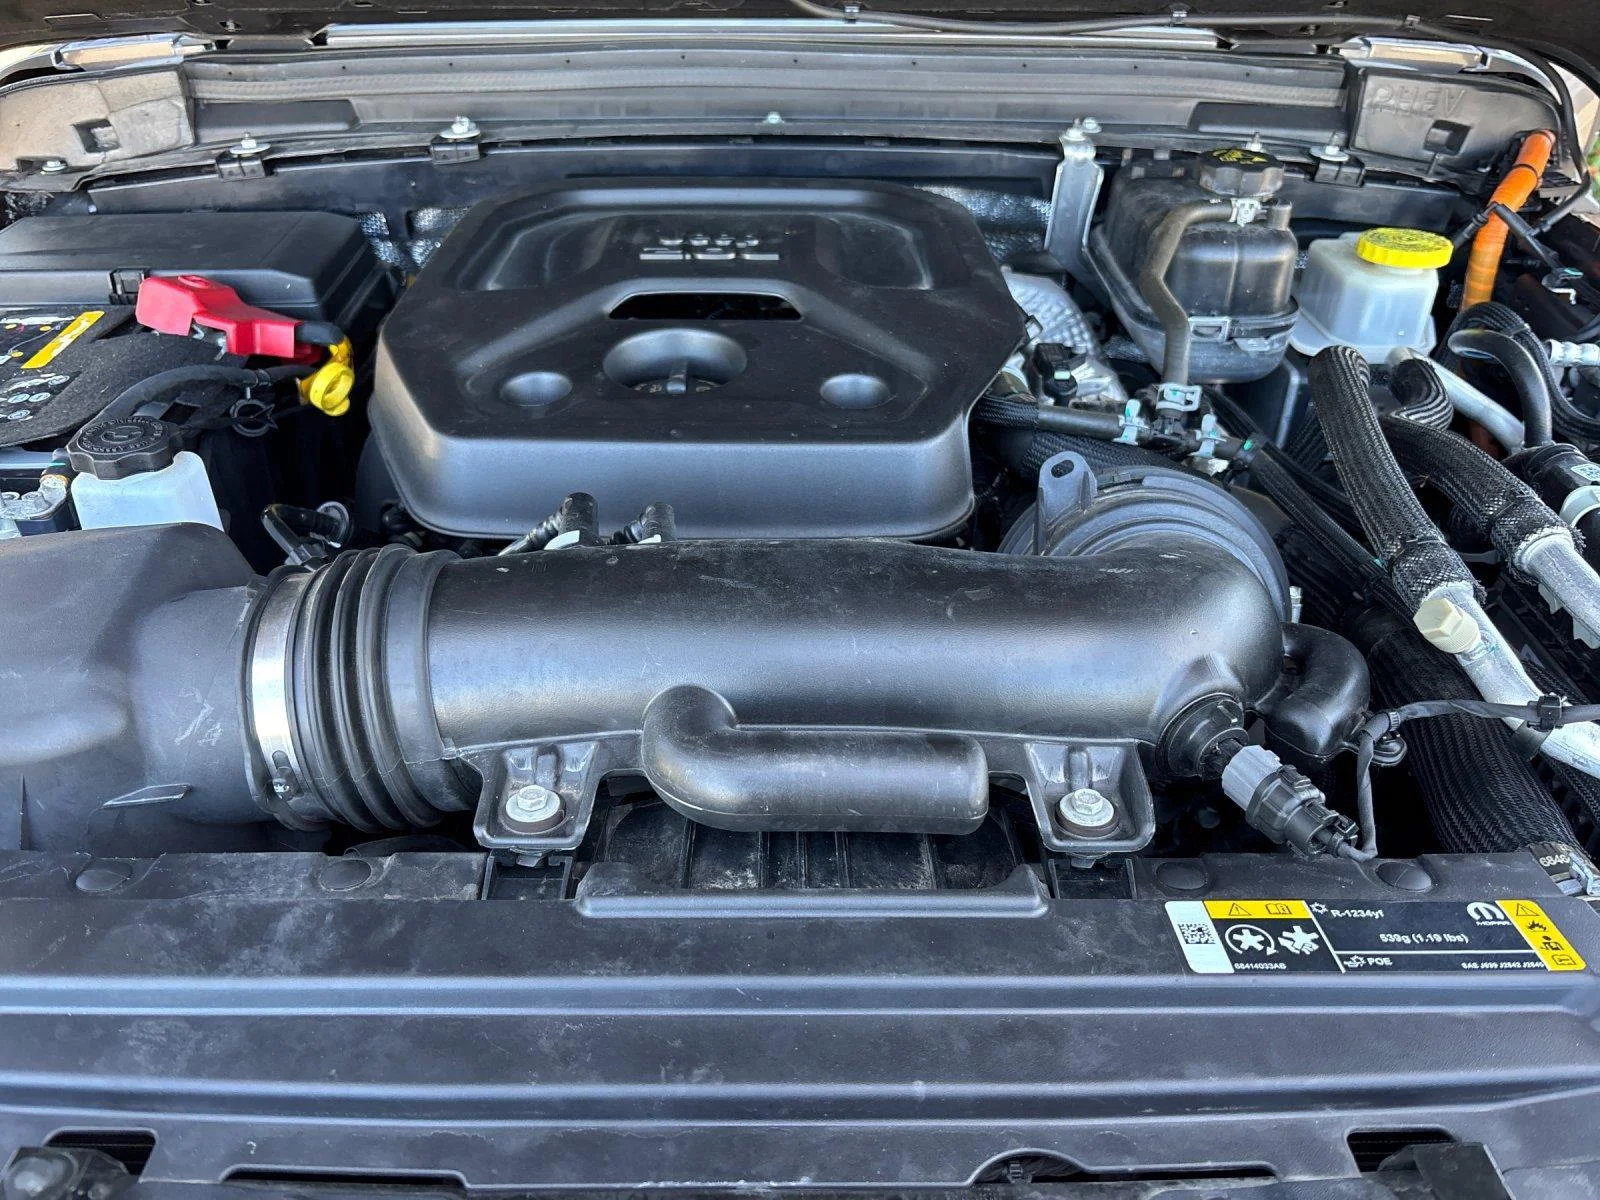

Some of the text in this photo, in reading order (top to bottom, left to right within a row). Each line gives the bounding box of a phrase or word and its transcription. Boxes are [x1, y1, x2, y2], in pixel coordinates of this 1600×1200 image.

[1331, 909, 1384, 919] R-1234yf
[1380, 933, 1469, 944] 539g (1.19 lbs)
[1366, 957, 1393, 966] POE
